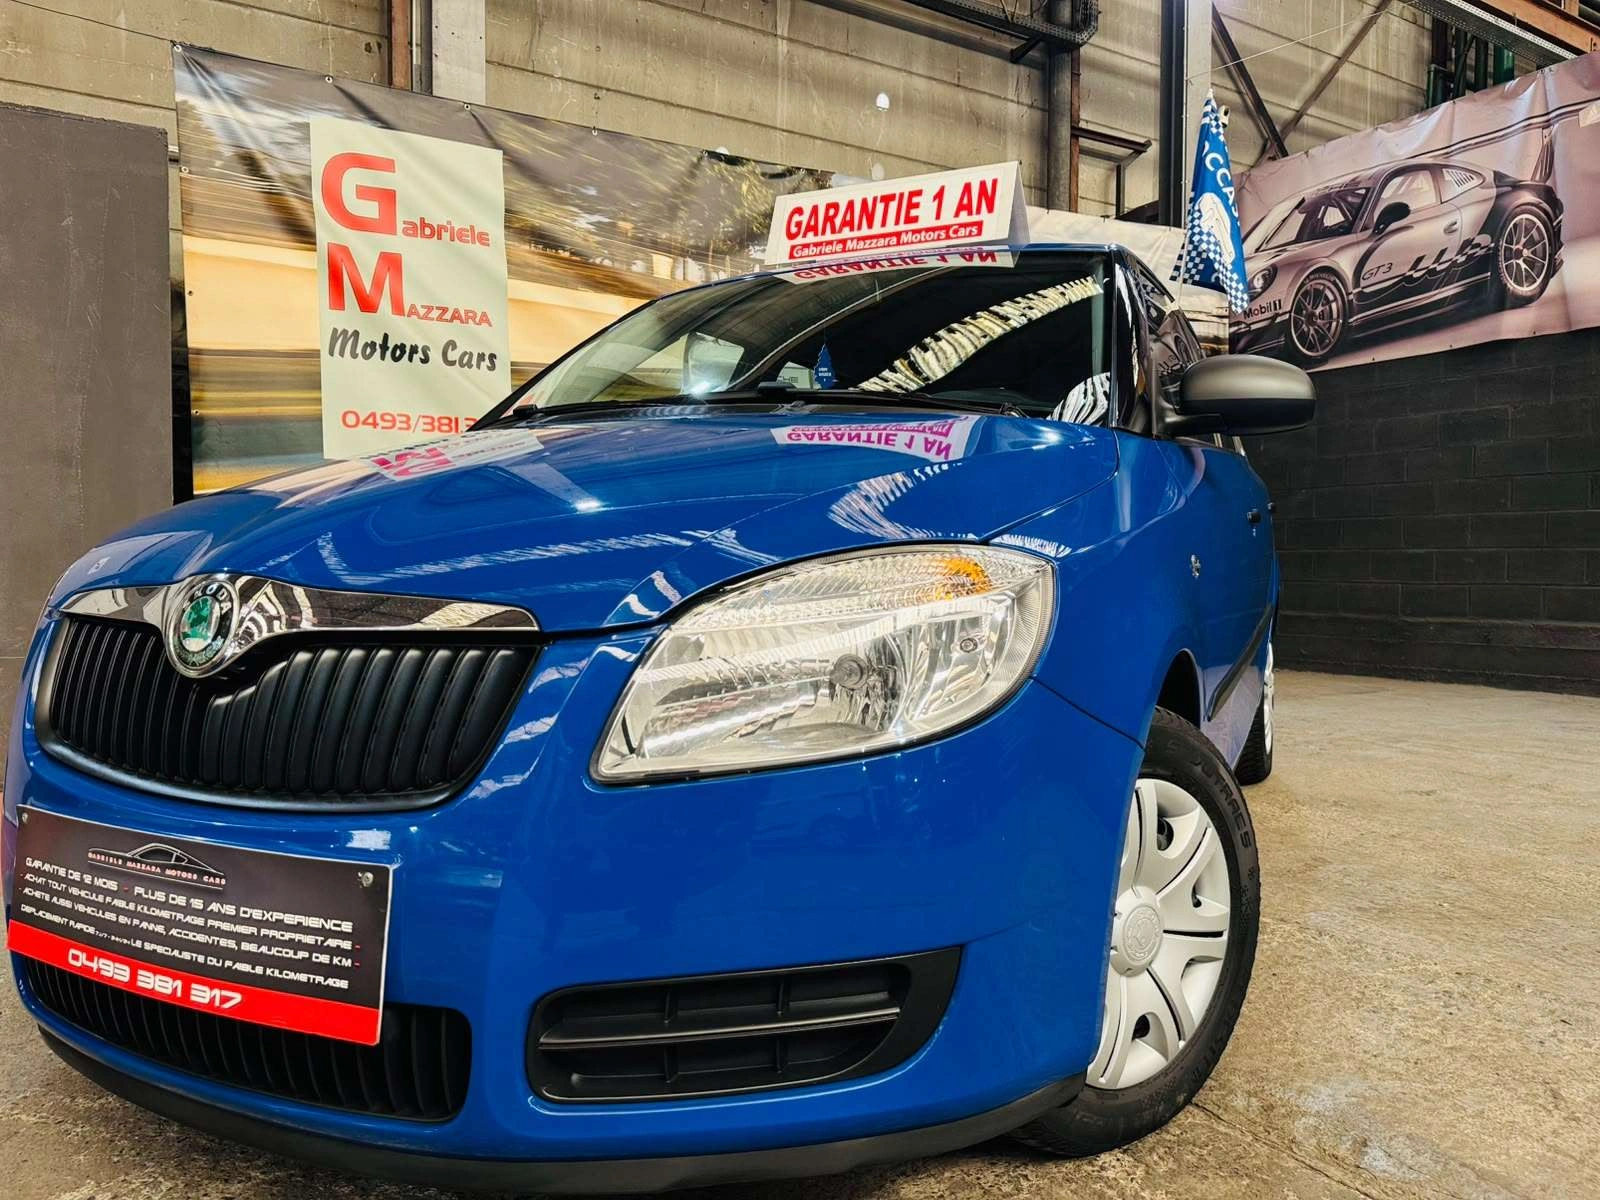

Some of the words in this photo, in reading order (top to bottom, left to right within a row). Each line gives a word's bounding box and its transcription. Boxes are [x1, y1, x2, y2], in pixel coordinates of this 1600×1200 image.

[321, 152, 491, 247] Gabriele
[785, 189, 922, 240] GARANTIE
[932, 185, 946, 220] 1
[954, 178, 998, 218] AN
[793, 242, 849, 258] Gabriele
[846, 236, 897, 251] Mazzara
[900, 229, 945, 244] Motors
[949, 225, 978, 238] Cars
[1361, 262, 1393, 281] GT3
[327, 242, 493, 327] MAZZARA
[1243, 301, 1272, 320] Mobil
[328, 327, 431, 364] Motors
[441, 339, 497, 371] Cars
[26, 857, 66, 877] GARANTIE
[67, 869, 81, 881] DE
[82, 873, 92, 884] 12
[94, 876, 118, 891] MOIS
[134, 886, 166, 902] PLUS
[169, 894, 187, 906] DE
[190, 898, 204, 910] 15
[207, 902, 236, 916] ANS
[240, 906, 353, 933] D'EXPERIENCE
[165, 868, 198, 880] MOTORS
[203, 875, 226, 885] CARS
[23, 887, 51, 902] ACHETE
[51, 896, 72, 909] AUSSI
[73, 902, 117, 922] VEHICULES
[118, 914, 131, 926] EN
[132, 918, 166, 935] PANNE,
[168, 928, 238, 950] ACCIDENTES,
[241, 941, 309, 960] BEAUCOUP
[312, 952, 330, 964] DE
[332, 956, 352, 968] KM
[24, 873, 46, 885] ACHAT
[47, 879, 67, 892] TOUT
[67, 886, 104, 903] VEHICULE
[105, 896, 136, 911] FAIBLE
[137, 904, 205, 926] KILOMETRAGE
[207, 918, 257, 936] PREMIER
[260, 928, 353, 950] PROPRIETAIRE
[21, 904, 69, 926] DEPLACEMENT
[69, 920, 96, 935] RAPIDE
[131, 938, 143, 949] LE
[144, 942, 205, 964] SPECIALISTE
[207, 957, 222, 967] DU
[224, 960, 264, 975] FAIBLE
[266, 967, 349, 990] KILOMETRAGE
[68, 948, 131, 983] 0493
[136, 969, 182, 998] 381
[190, 983, 242, 1009] 317
